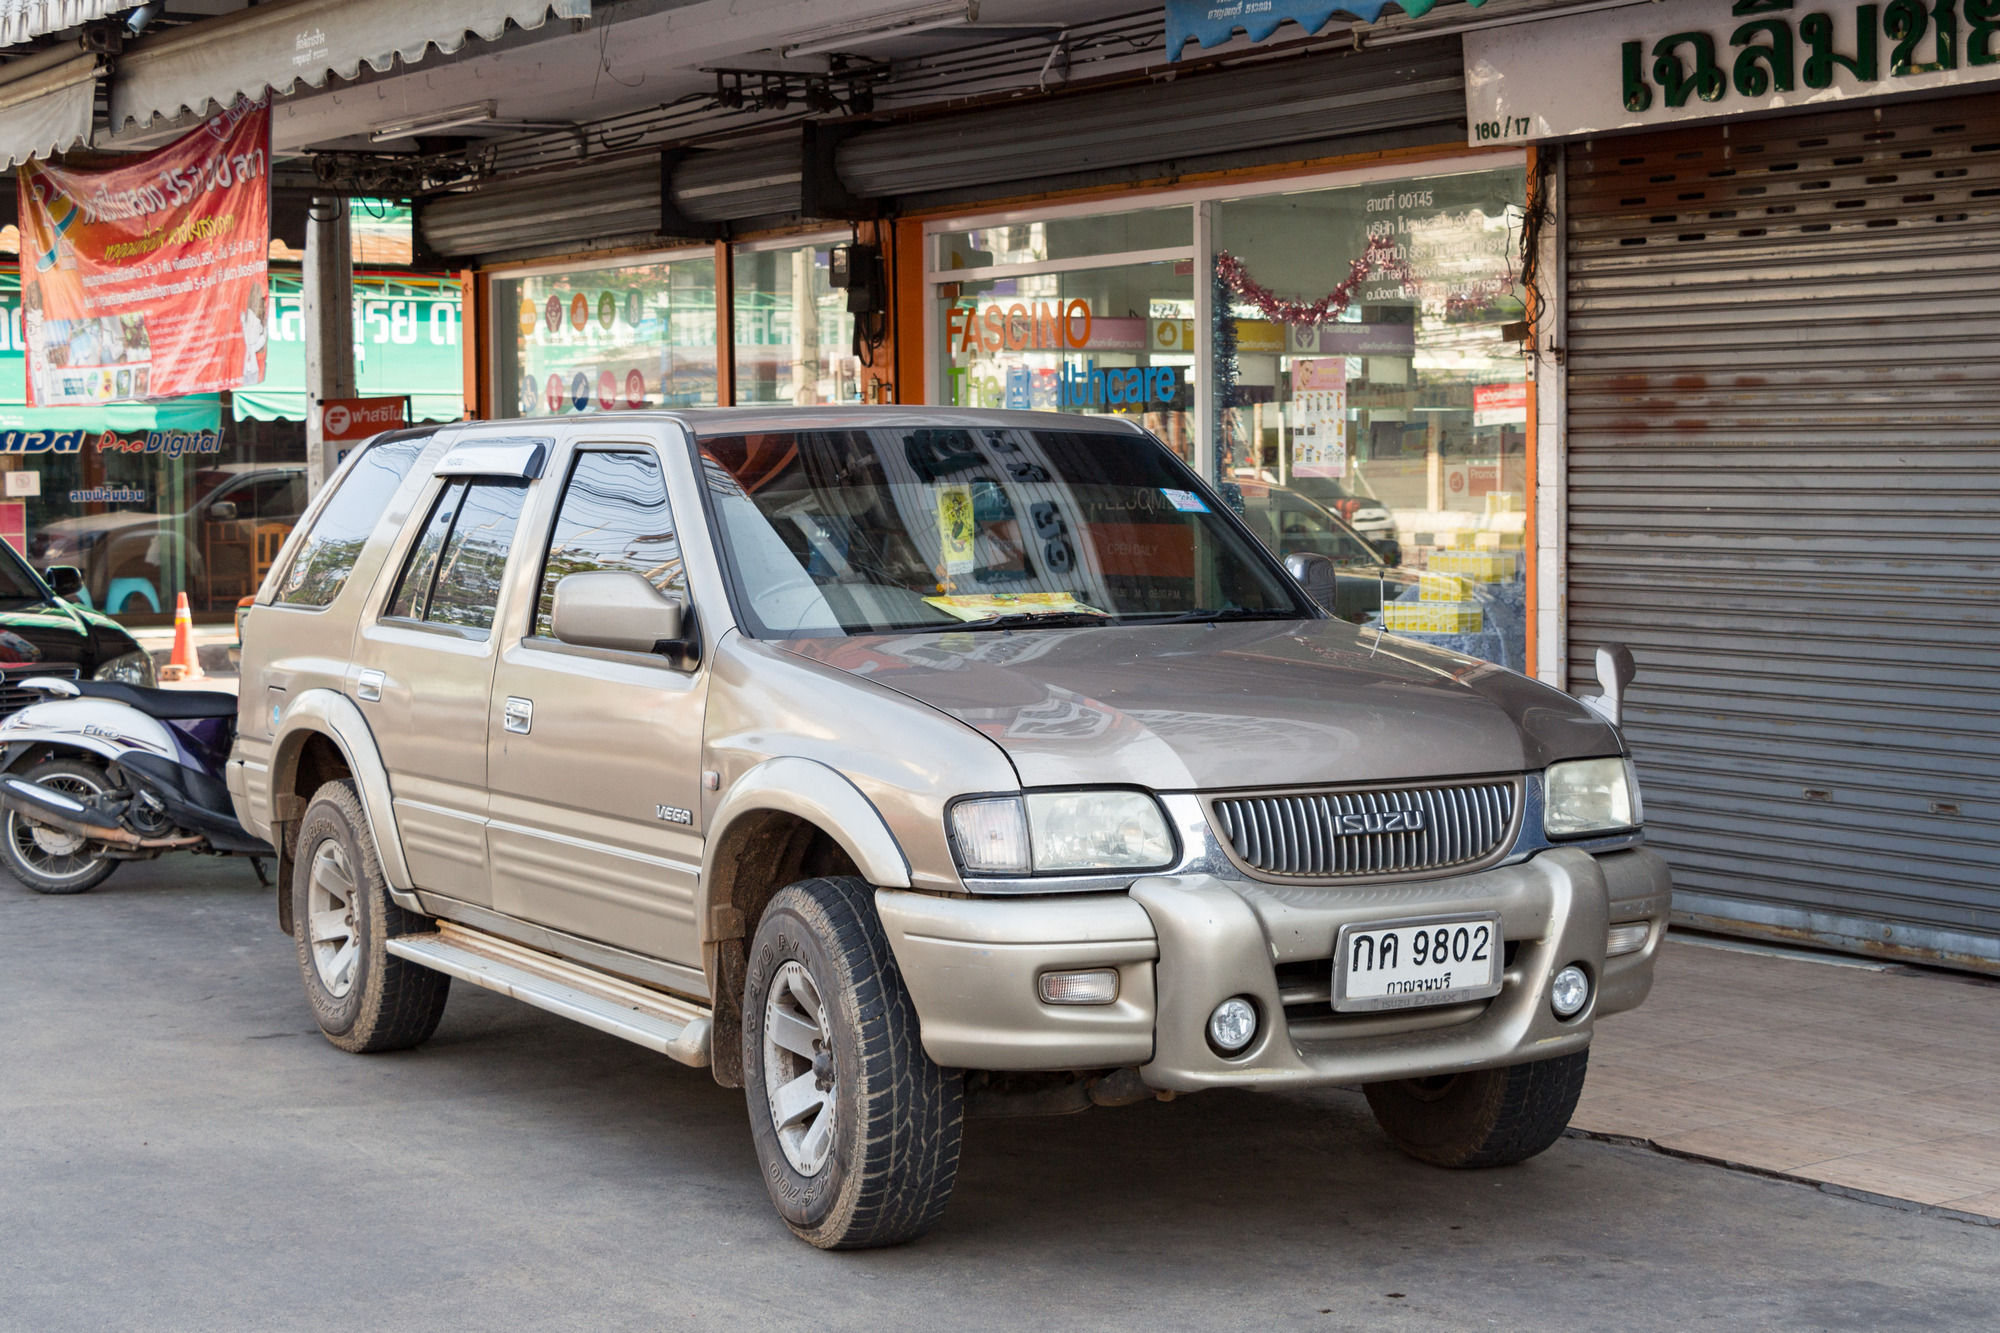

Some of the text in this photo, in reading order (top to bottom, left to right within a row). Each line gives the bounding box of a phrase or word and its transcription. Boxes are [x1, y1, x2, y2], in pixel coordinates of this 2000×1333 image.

[946, 298, 1092, 354] FASCINO
[947, 359, 1176, 409] The Healthcare
[656, 804, 693, 826] VEGA
[1334, 810, 1424, 835] ISUZU
[1352, 925, 1490, 973] กค 9802
[745, 948, 774, 1077] BRAVO
